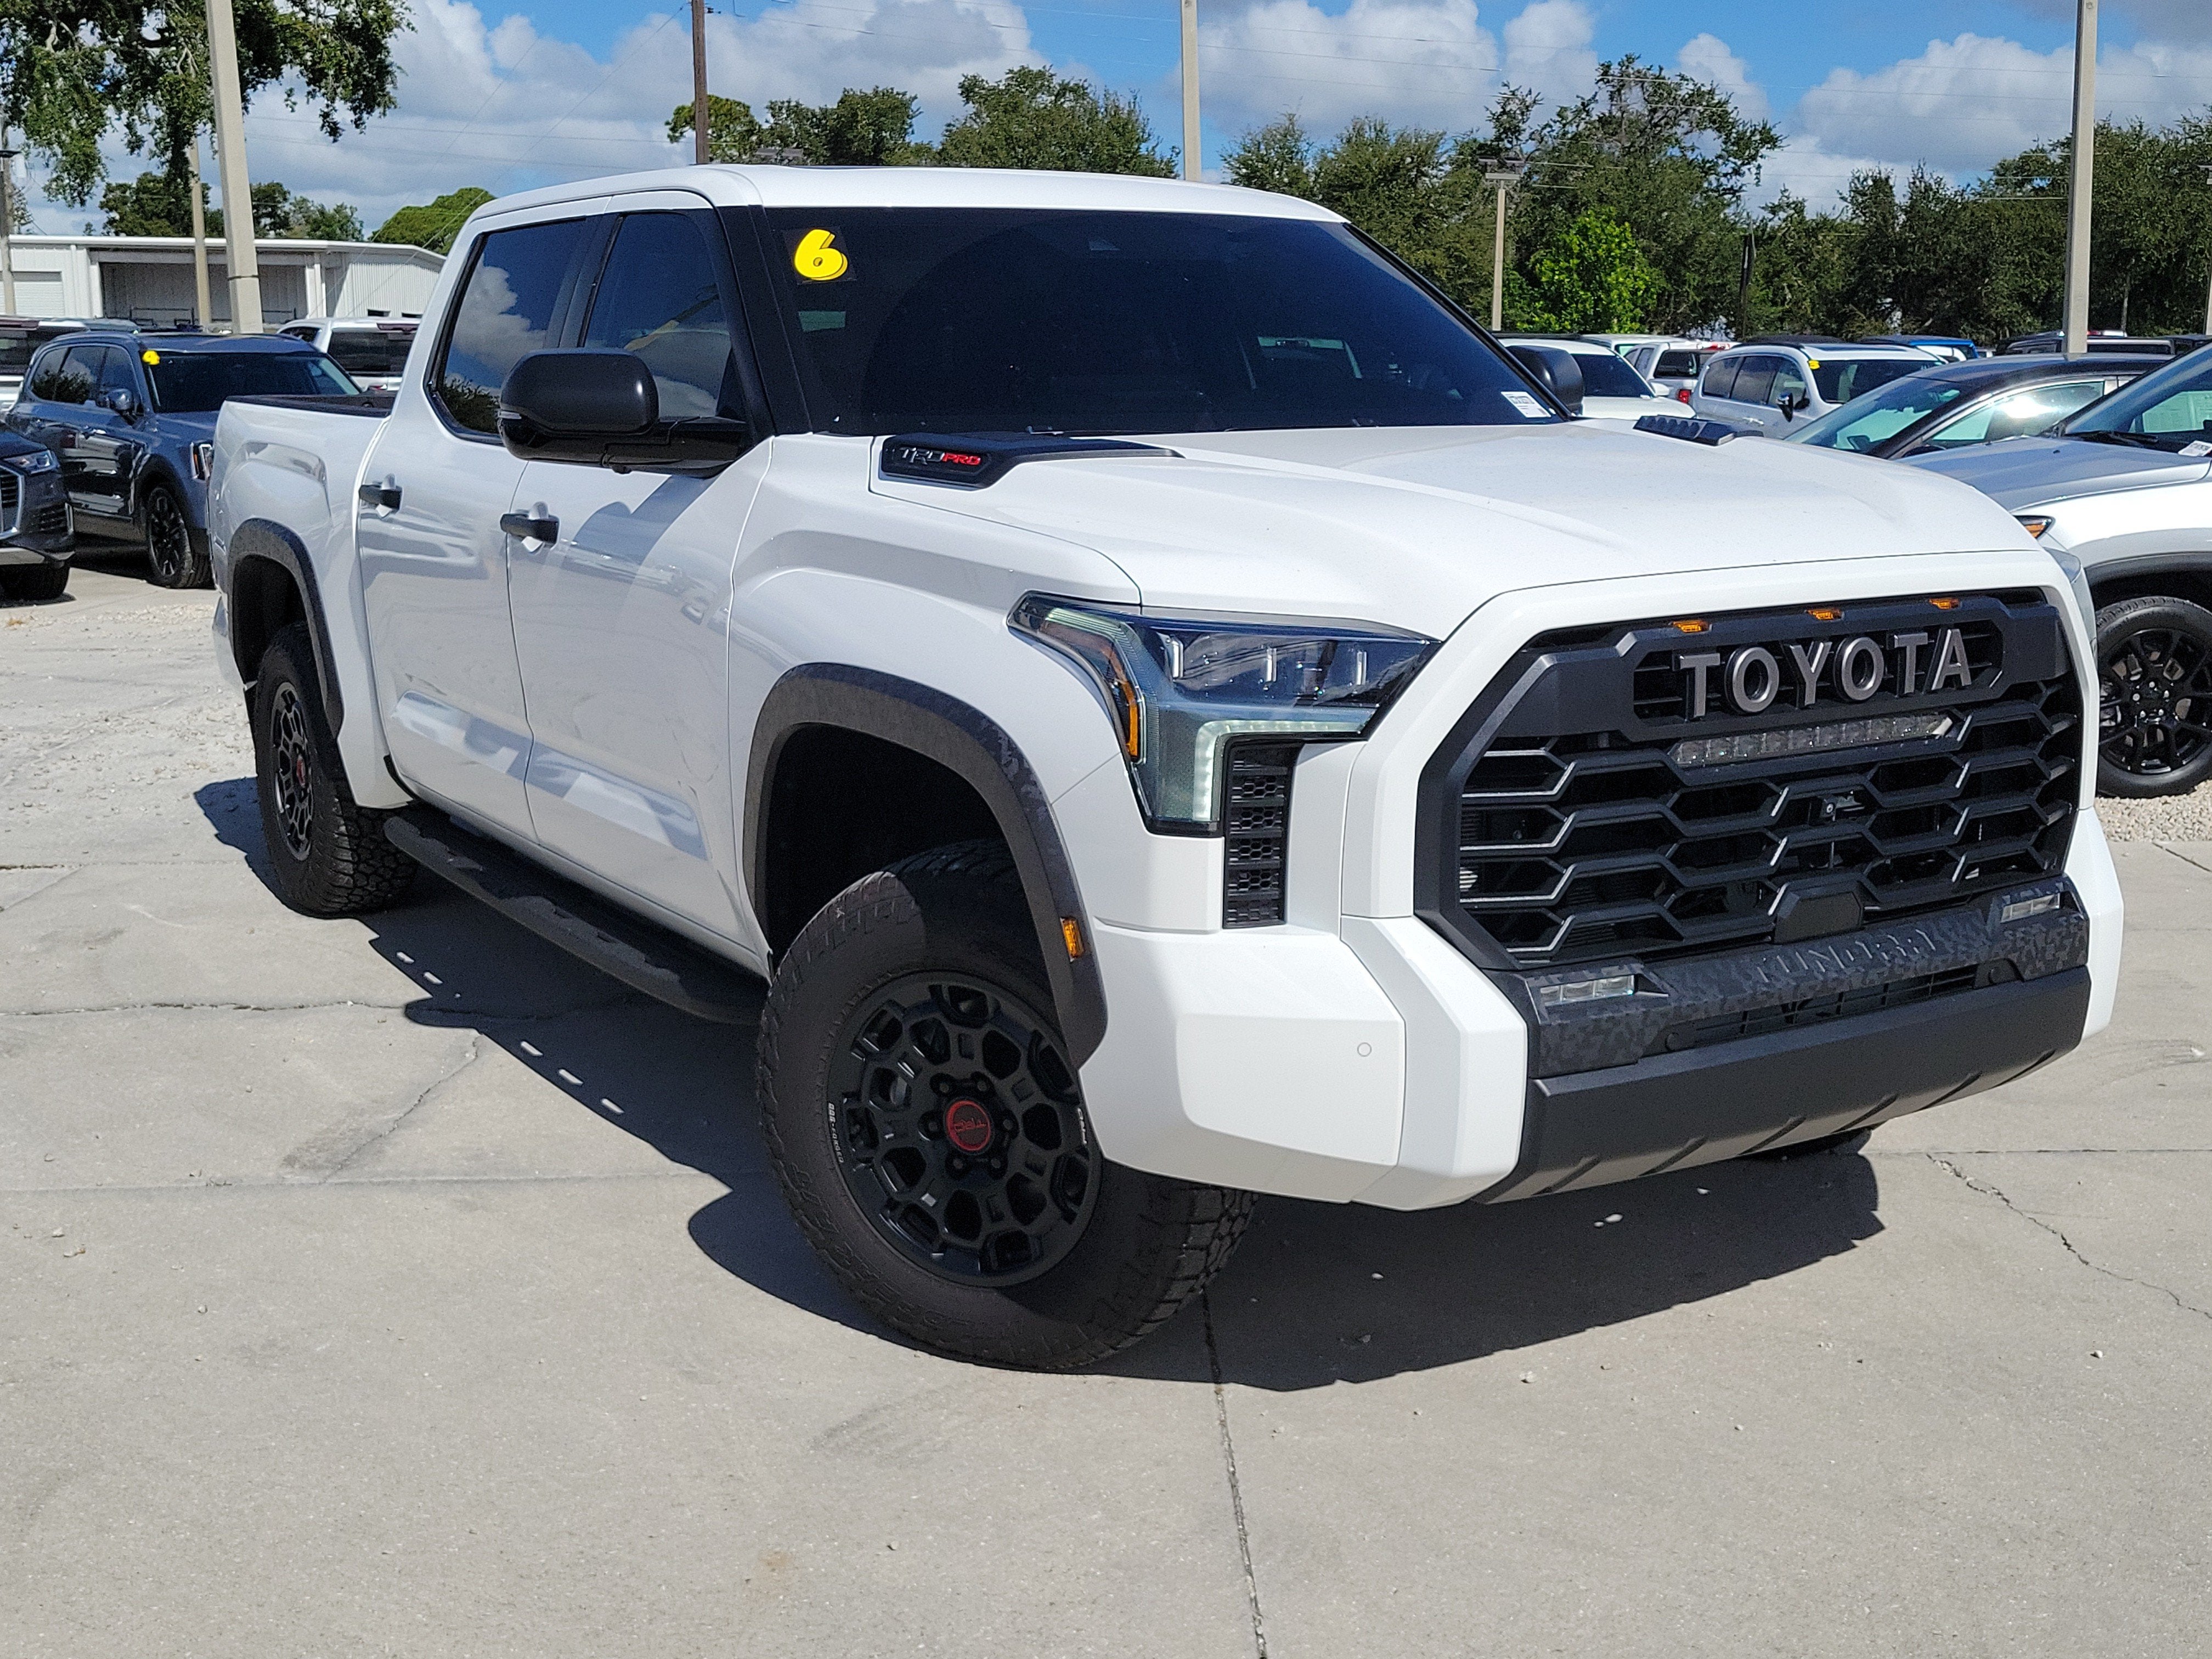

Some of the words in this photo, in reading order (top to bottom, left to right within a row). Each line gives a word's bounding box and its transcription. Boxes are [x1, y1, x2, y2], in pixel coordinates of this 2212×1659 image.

[794, 228, 848, 281] 6
[900, 446, 945, 465] TRD
[941, 452, 982, 466] PRO
[1677, 628, 1972, 718] TOYOTA
[1750, 928, 1937, 984] TUNDRA
